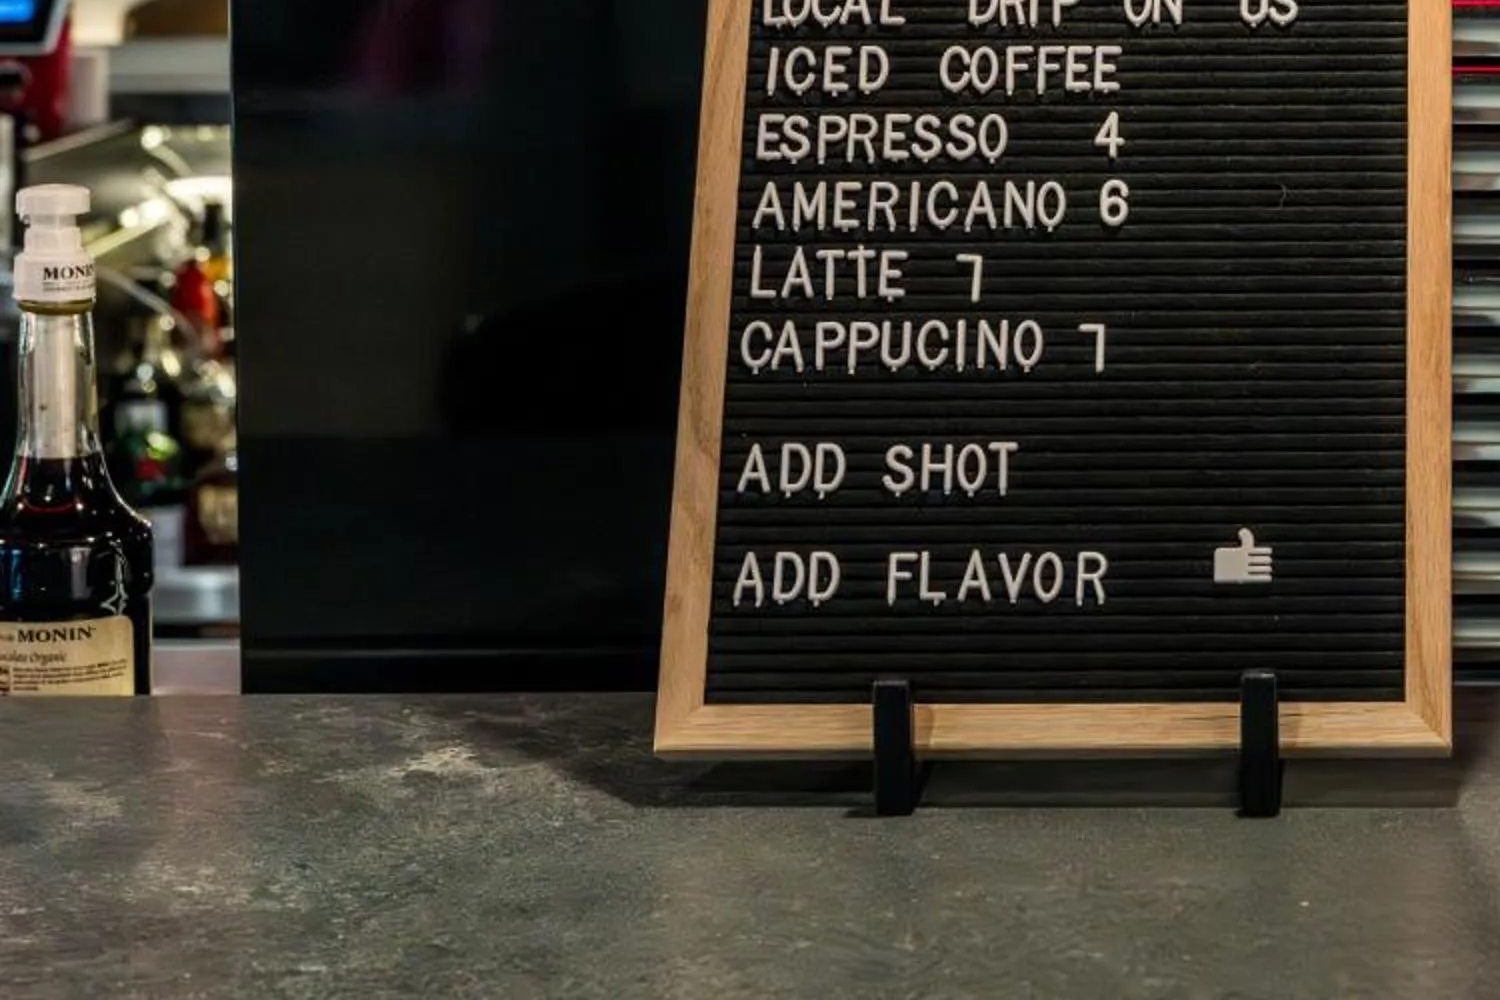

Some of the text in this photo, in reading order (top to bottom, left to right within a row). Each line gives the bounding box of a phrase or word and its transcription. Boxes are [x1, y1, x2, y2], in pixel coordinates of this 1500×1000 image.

[767, 45, 1123, 97] ICED COFFEE
[756, 111, 1125, 165] ESPRESSO 4
[752, 178, 1129, 233] AMERICANO 6
[750, 245, 983, 302] LATTE 7
[741, 319, 1105, 375] CAPPUCINO 7
[737, 441, 1018, 499] ADD SHOT
[733, 549, 1108, 608] ADD FLAVOR
